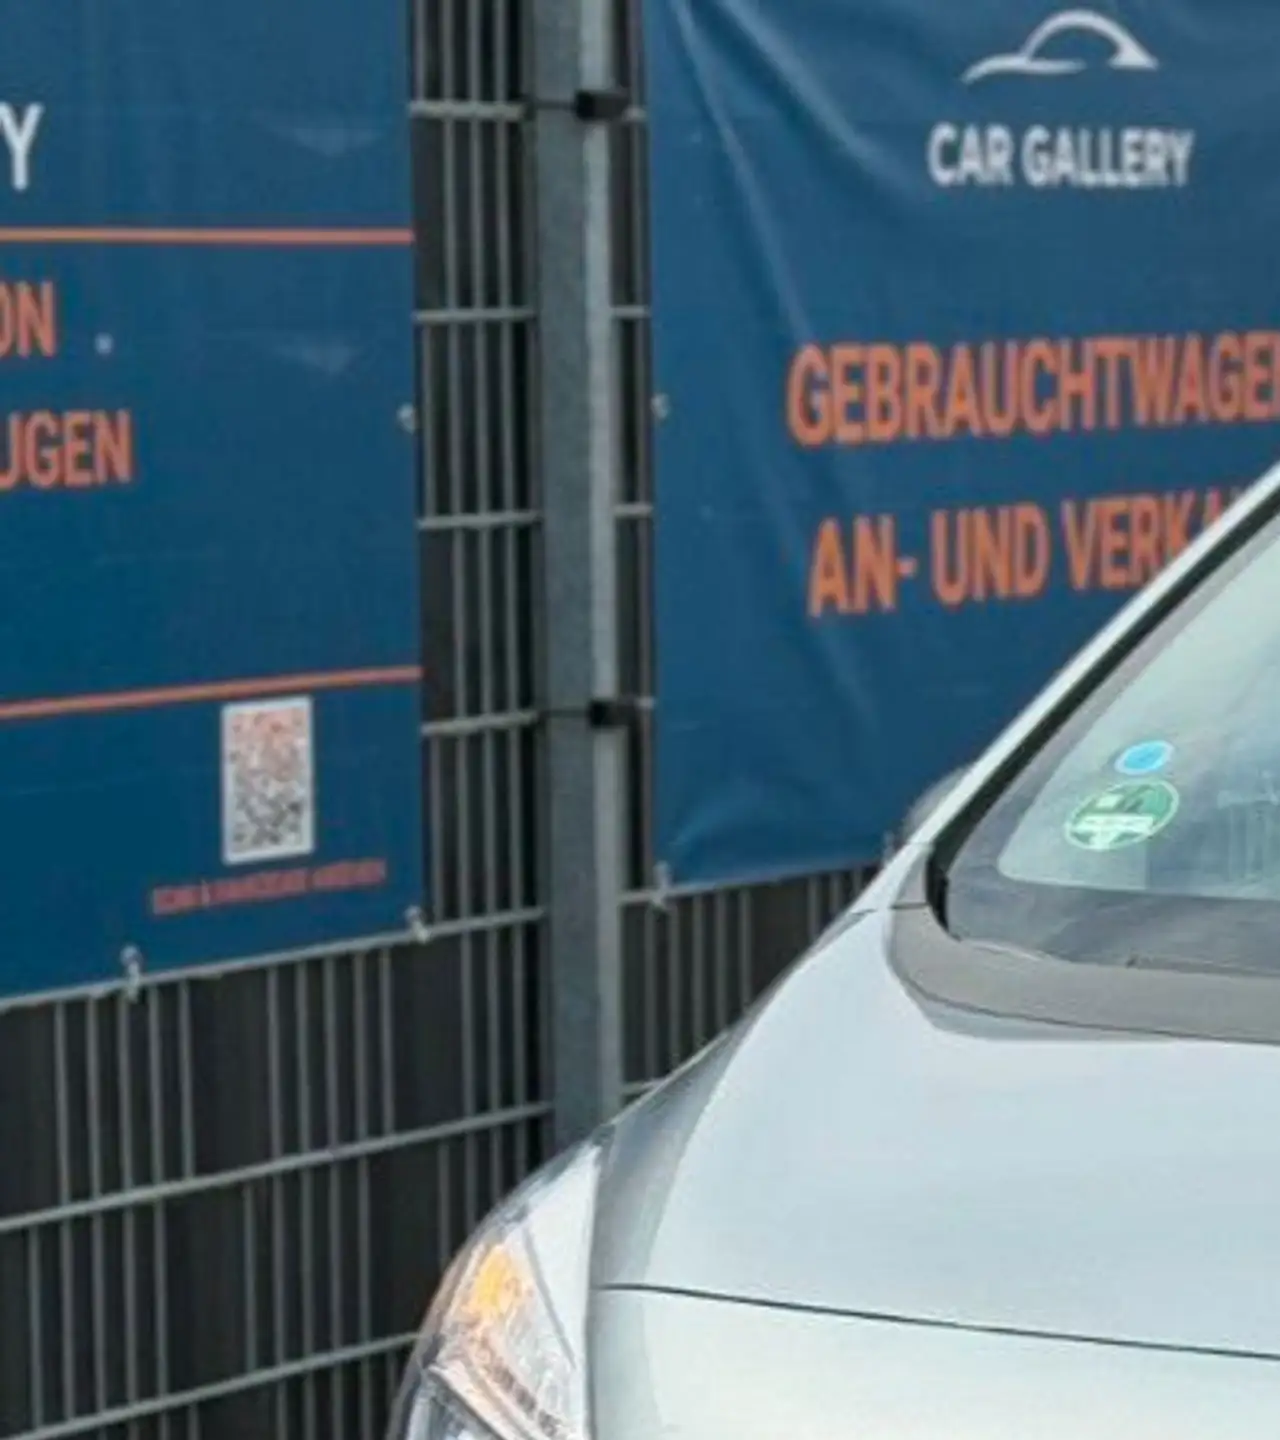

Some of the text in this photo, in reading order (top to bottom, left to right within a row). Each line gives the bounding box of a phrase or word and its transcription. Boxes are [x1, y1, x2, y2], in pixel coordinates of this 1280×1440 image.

[927, 121, 1194, 188] CAR GALLERY
[808, 516, 917, 618] AN-
[931, 499, 1049, 607] UND
